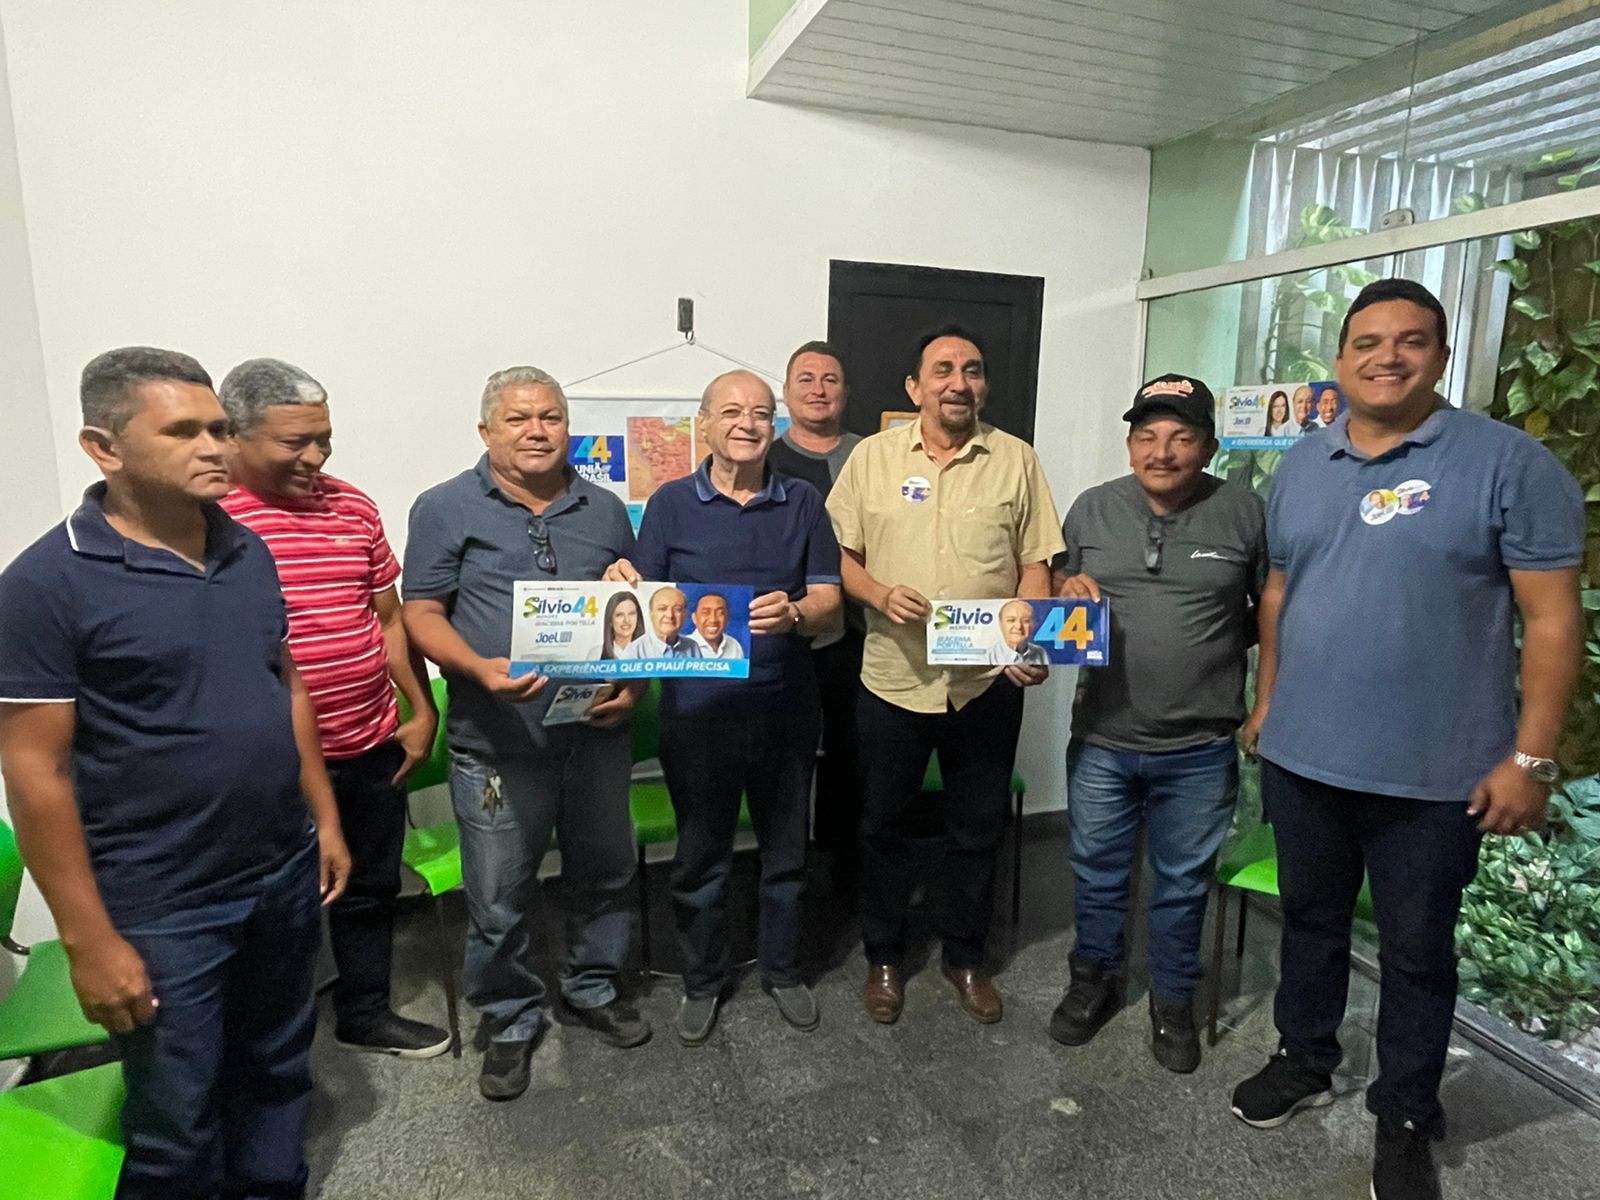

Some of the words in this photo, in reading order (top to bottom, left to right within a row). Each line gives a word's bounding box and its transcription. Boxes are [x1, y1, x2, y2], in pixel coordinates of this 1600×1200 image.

[574, 435, 612, 464] 44
[523, 596, 572, 618] Silvio
[571, 595, 599, 618] 44
[934, 605, 993, 630] Silvio
[535, 630, 559, 644] Joel
[1033, 606, 1094, 650] 44
[533, 664, 541, 673] A
[543, 662, 617, 674] EXPERIÊNCIA
[619, 662, 642, 673] QUE
[645, 662, 653, 672] O
[655, 659, 685, 672] PIAUÍ
[685, 661, 730, 673] PRECISA
